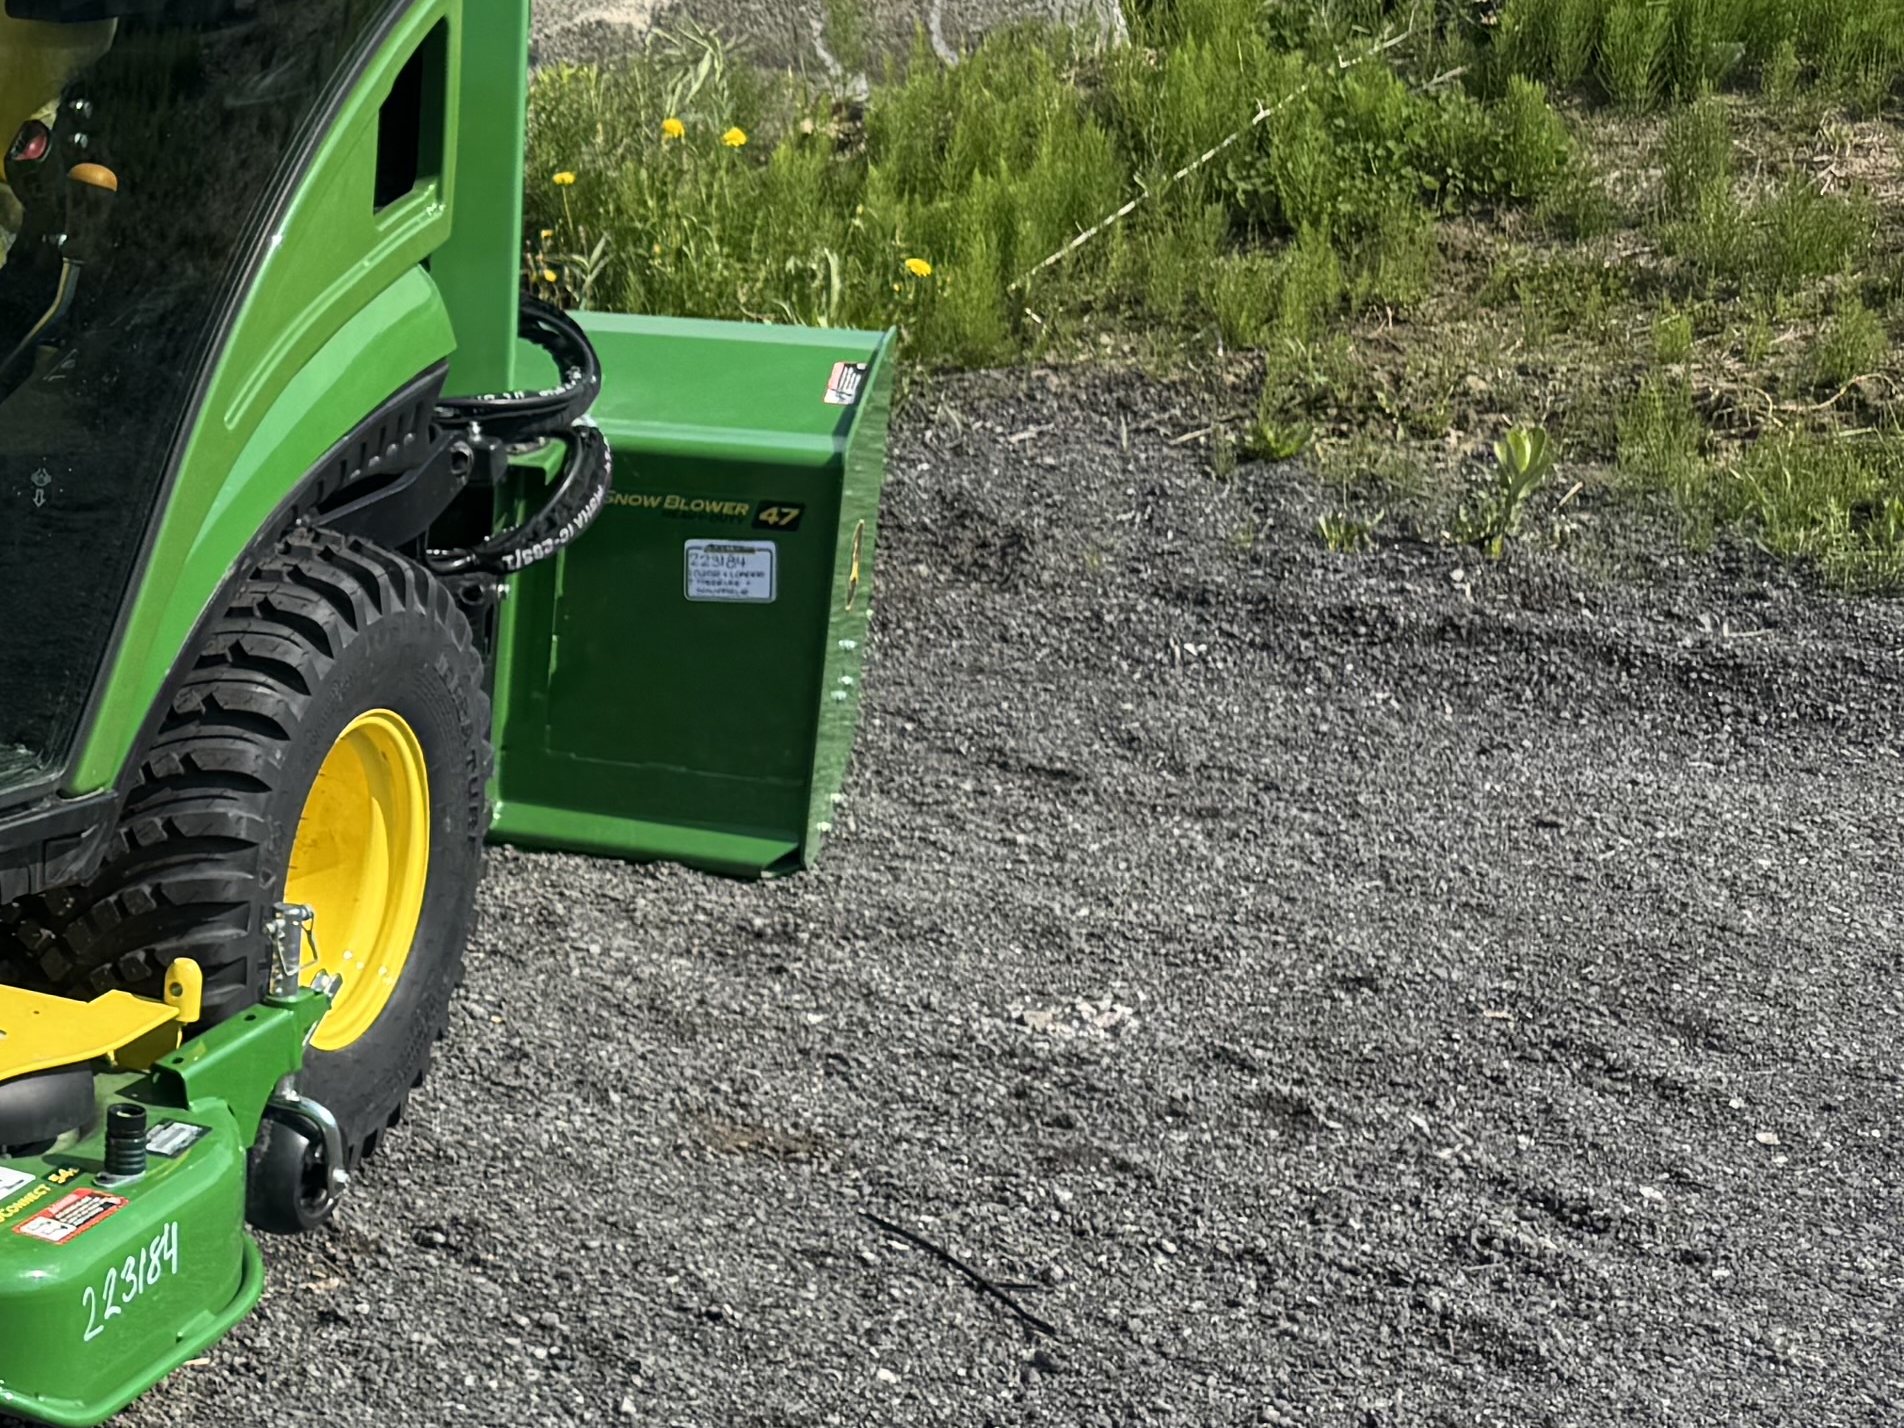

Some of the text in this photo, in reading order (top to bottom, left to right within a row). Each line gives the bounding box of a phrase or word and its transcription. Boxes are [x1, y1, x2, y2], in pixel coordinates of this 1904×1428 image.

[663, 494, 751, 516] BLOWER
[758, 505, 801, 526] 47
[82, 1220, 181, 1343] 223184
